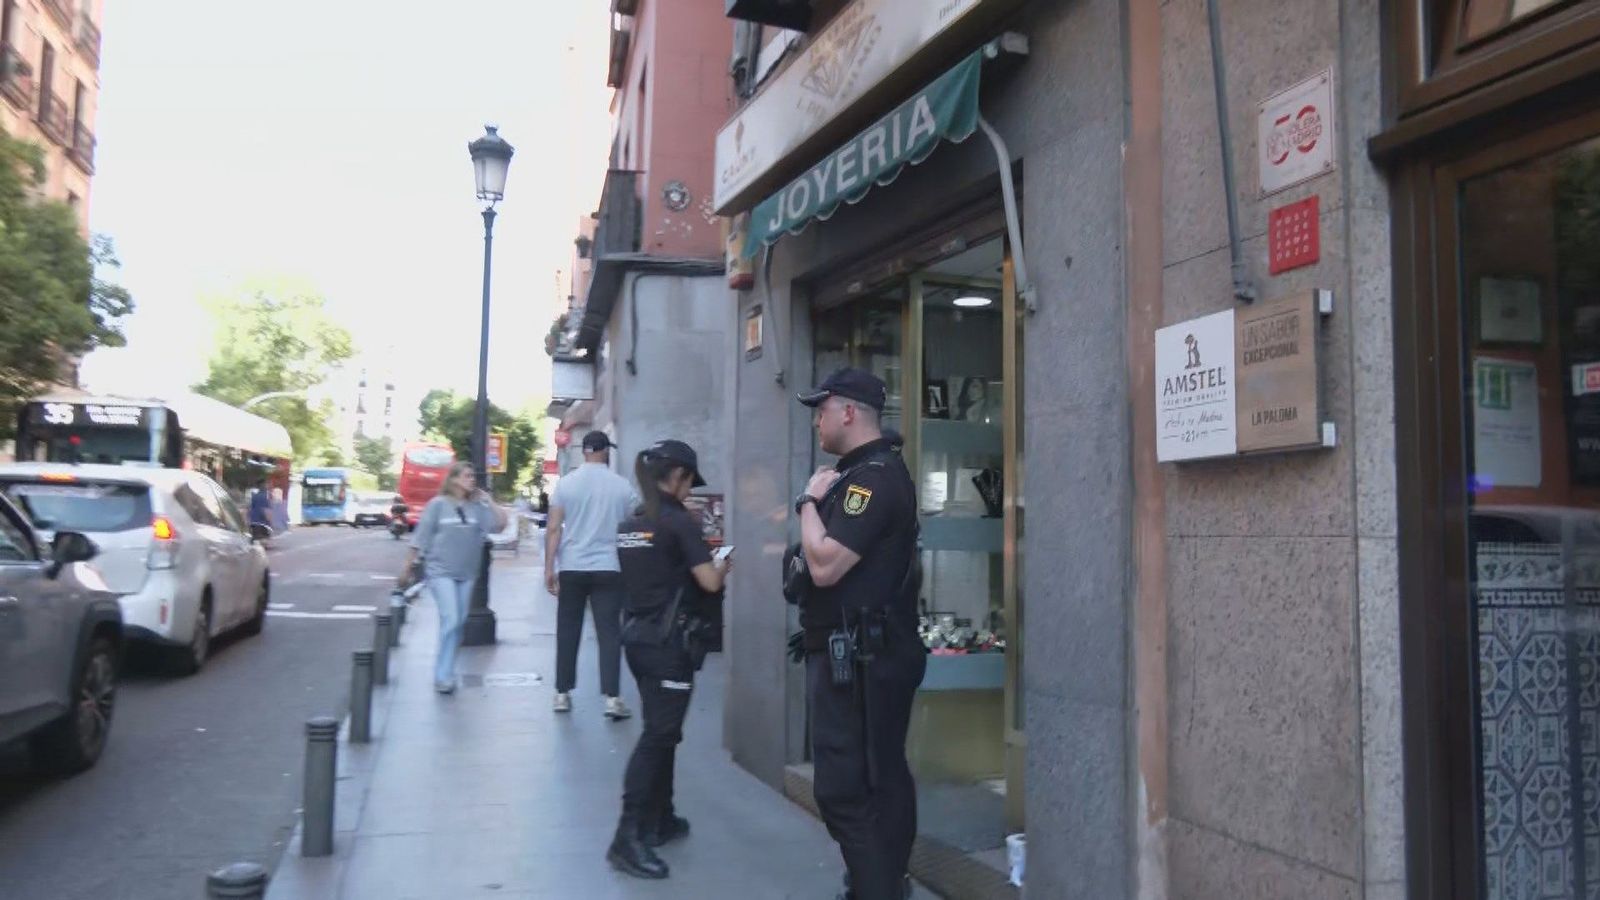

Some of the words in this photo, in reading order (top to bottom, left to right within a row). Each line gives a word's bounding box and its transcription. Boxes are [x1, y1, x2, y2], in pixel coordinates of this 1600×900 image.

[768, 95, 936, 232] JOYERIA
[1243, 341, 1299, 366] EXCEPCIONAL
[1163, 366, 1226, 397] AMSTEL
[1251, 411, 1262, 426] LA
[1263, 406, 1298, 424] PALOMA
